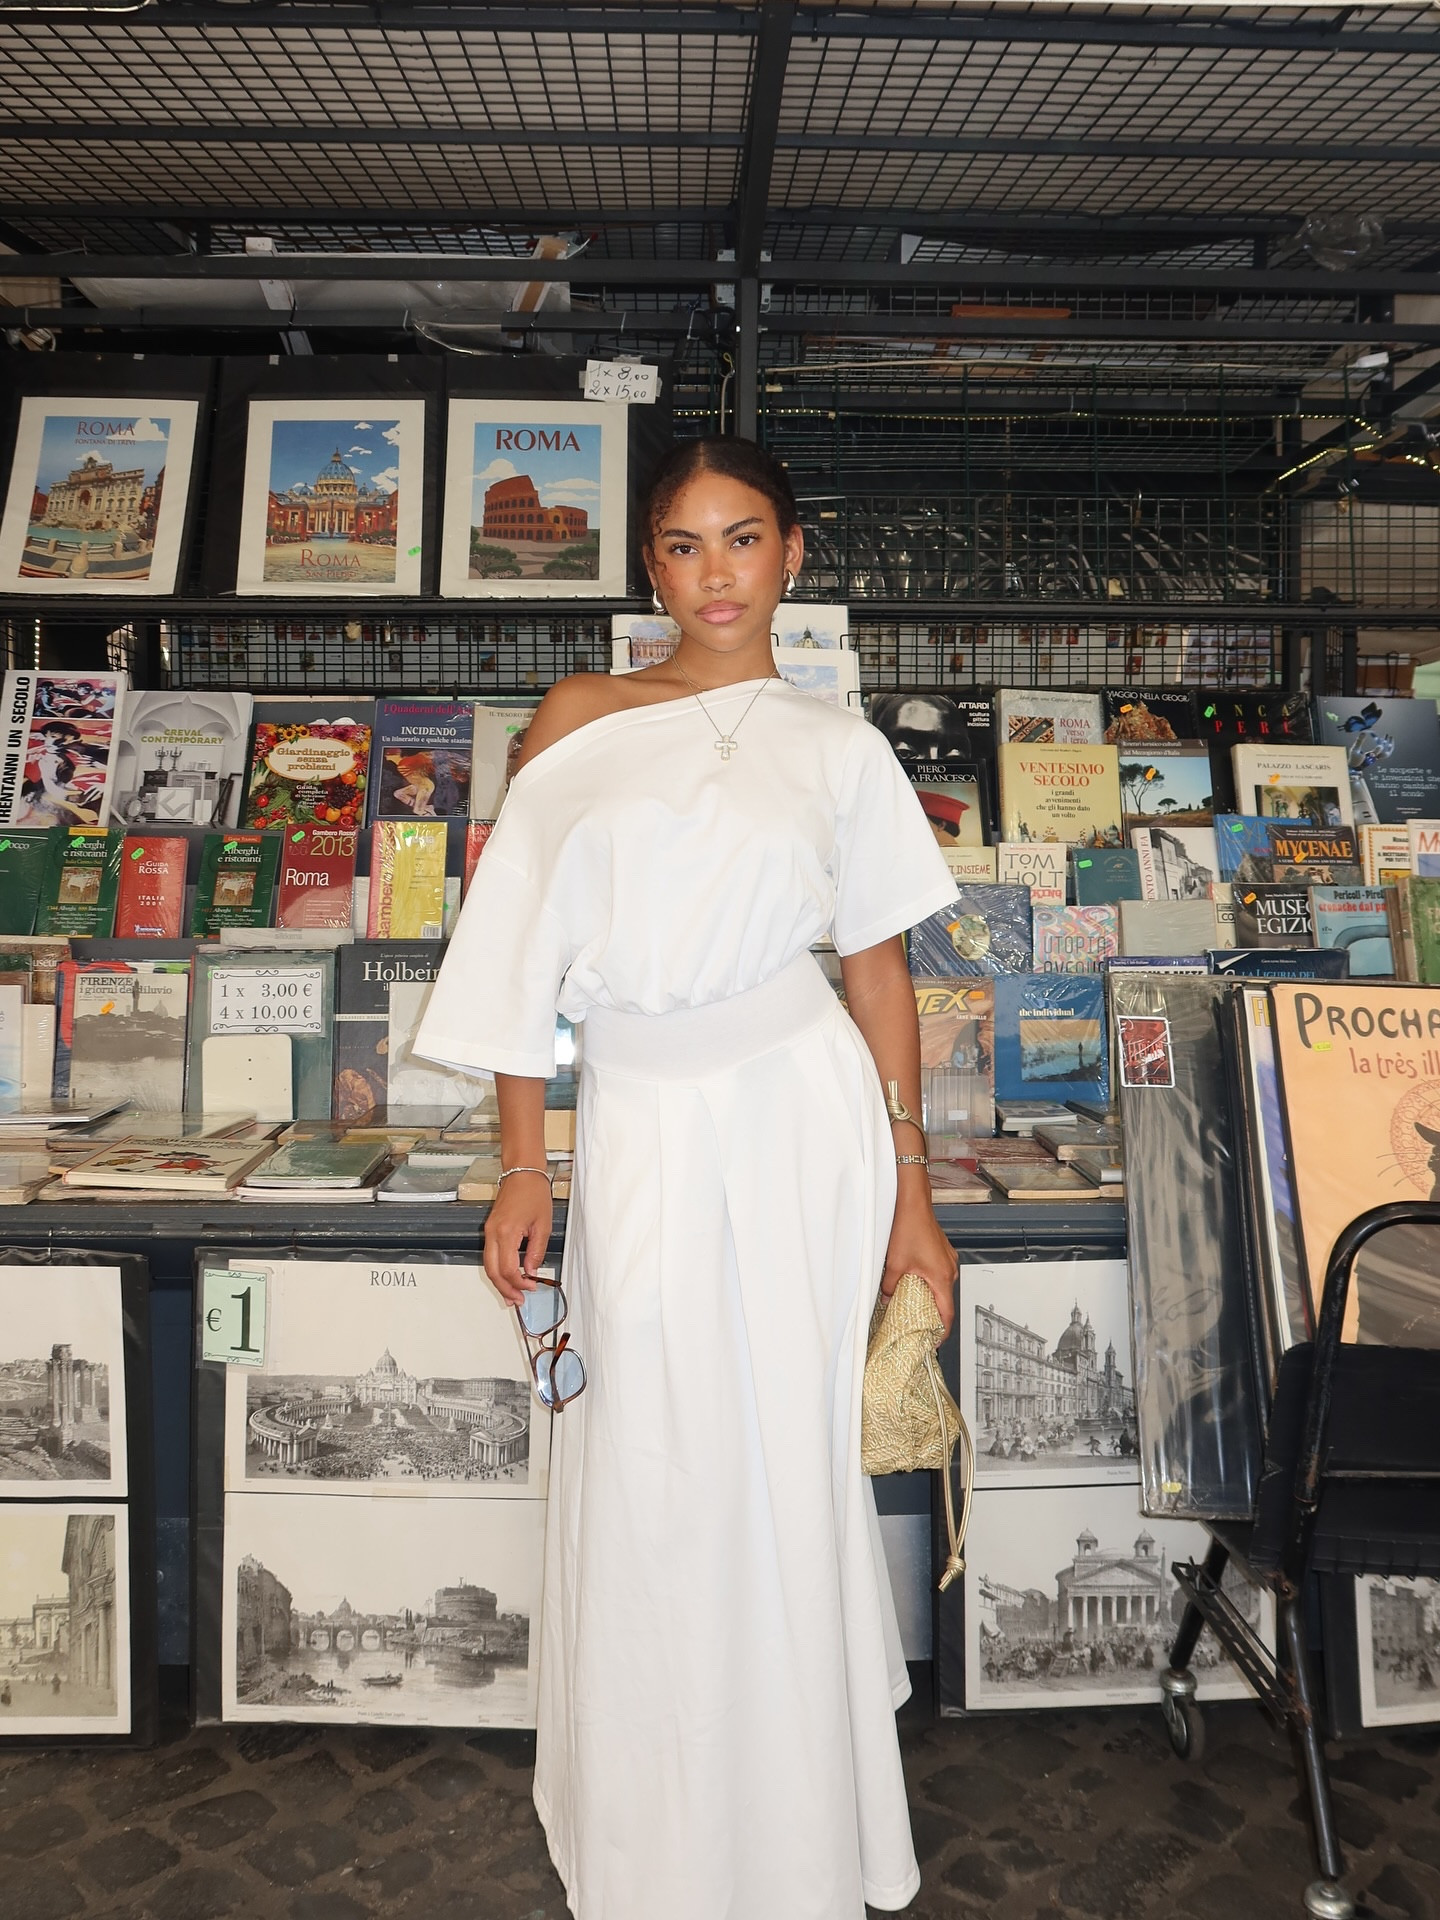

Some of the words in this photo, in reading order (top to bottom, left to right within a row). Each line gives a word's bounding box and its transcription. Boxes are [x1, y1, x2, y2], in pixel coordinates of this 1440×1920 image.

[77, 421, 135, 436] ROMA
[495, 429, 581, 451] ROMA
[11, 676, 31, 724] SECOLO
[390, 703, 434, 714] Quaderni
[958, 702, 990, 710] ATTARDI
[1060, 718, 1091, 729] ROMA
[401, 726, 457, 736] INCIDENDO
[7, 729, 23, 748] UN
[141, 736, 225, 744] CONTEMPORARY
[382, 735, 391, 743] Un
[426, 737, 450, 745] qualche
[276, 747, 351, 758] Giardinaggio
[287, 763, 336, 771] problemi
[917, 765, 947, 774] PIERO
[1020, 761, 1105, 775] VENTESIMO
[919, 774, 978, 782] FRANCESCA
[1033, 774, 1090, 787] SECOLO
[1055, 789, 1075, 797] grandi
[1048, 804, 1056, 813] gli
[310, 835, 355, 857] 2013
[1140, 835, 1149, 847] FA
[69, 849, 108, 858] ristoranti
[1275, 839, 1353, 858] MYCENAE
[223, 854, 262, 863] ristoranti
[1004, 853, 1056, 869] TOM
[138, 866, 169, 874] ROSSA
[957, 864, 991, 875] INSIEME
[285, 868, 329, 887] Roma
[1004, 871, 1064, 888] HOLT
[1333, 890, 1361, 900] Pericoli
[1318, 902, 1357, 913] cronache
[1044, 936, 1106, 954] UTOPIA
[80, 976, 133, 986] FIRENZE
[80, 986, 84, 994] i
[84, 986, 118, 996] giorni
[220, 984, 229, 998] 1
[236, 987, 245, 998] x
[261, 983, 298, 999] 3,00
[303, 983, 313, 997] €
[219, 1005, 230, 1019] 4
[236, 1009, 245, 1019] x
[251, 1005, 298, 1021] 10,00
[303, 1005, 313, 1018] €
[1019, 1008, 1033, 1016] the
[1033, 1007, 1075, 1016] individual
[1348, 1047, 1371, 1074] la
[1377, 1052, 1418, 1079] très
[370, 1270, 418, 1287] ROMA
[206, 1308, 222, 1332] €
[230, 1286, 260, 1353] 1
